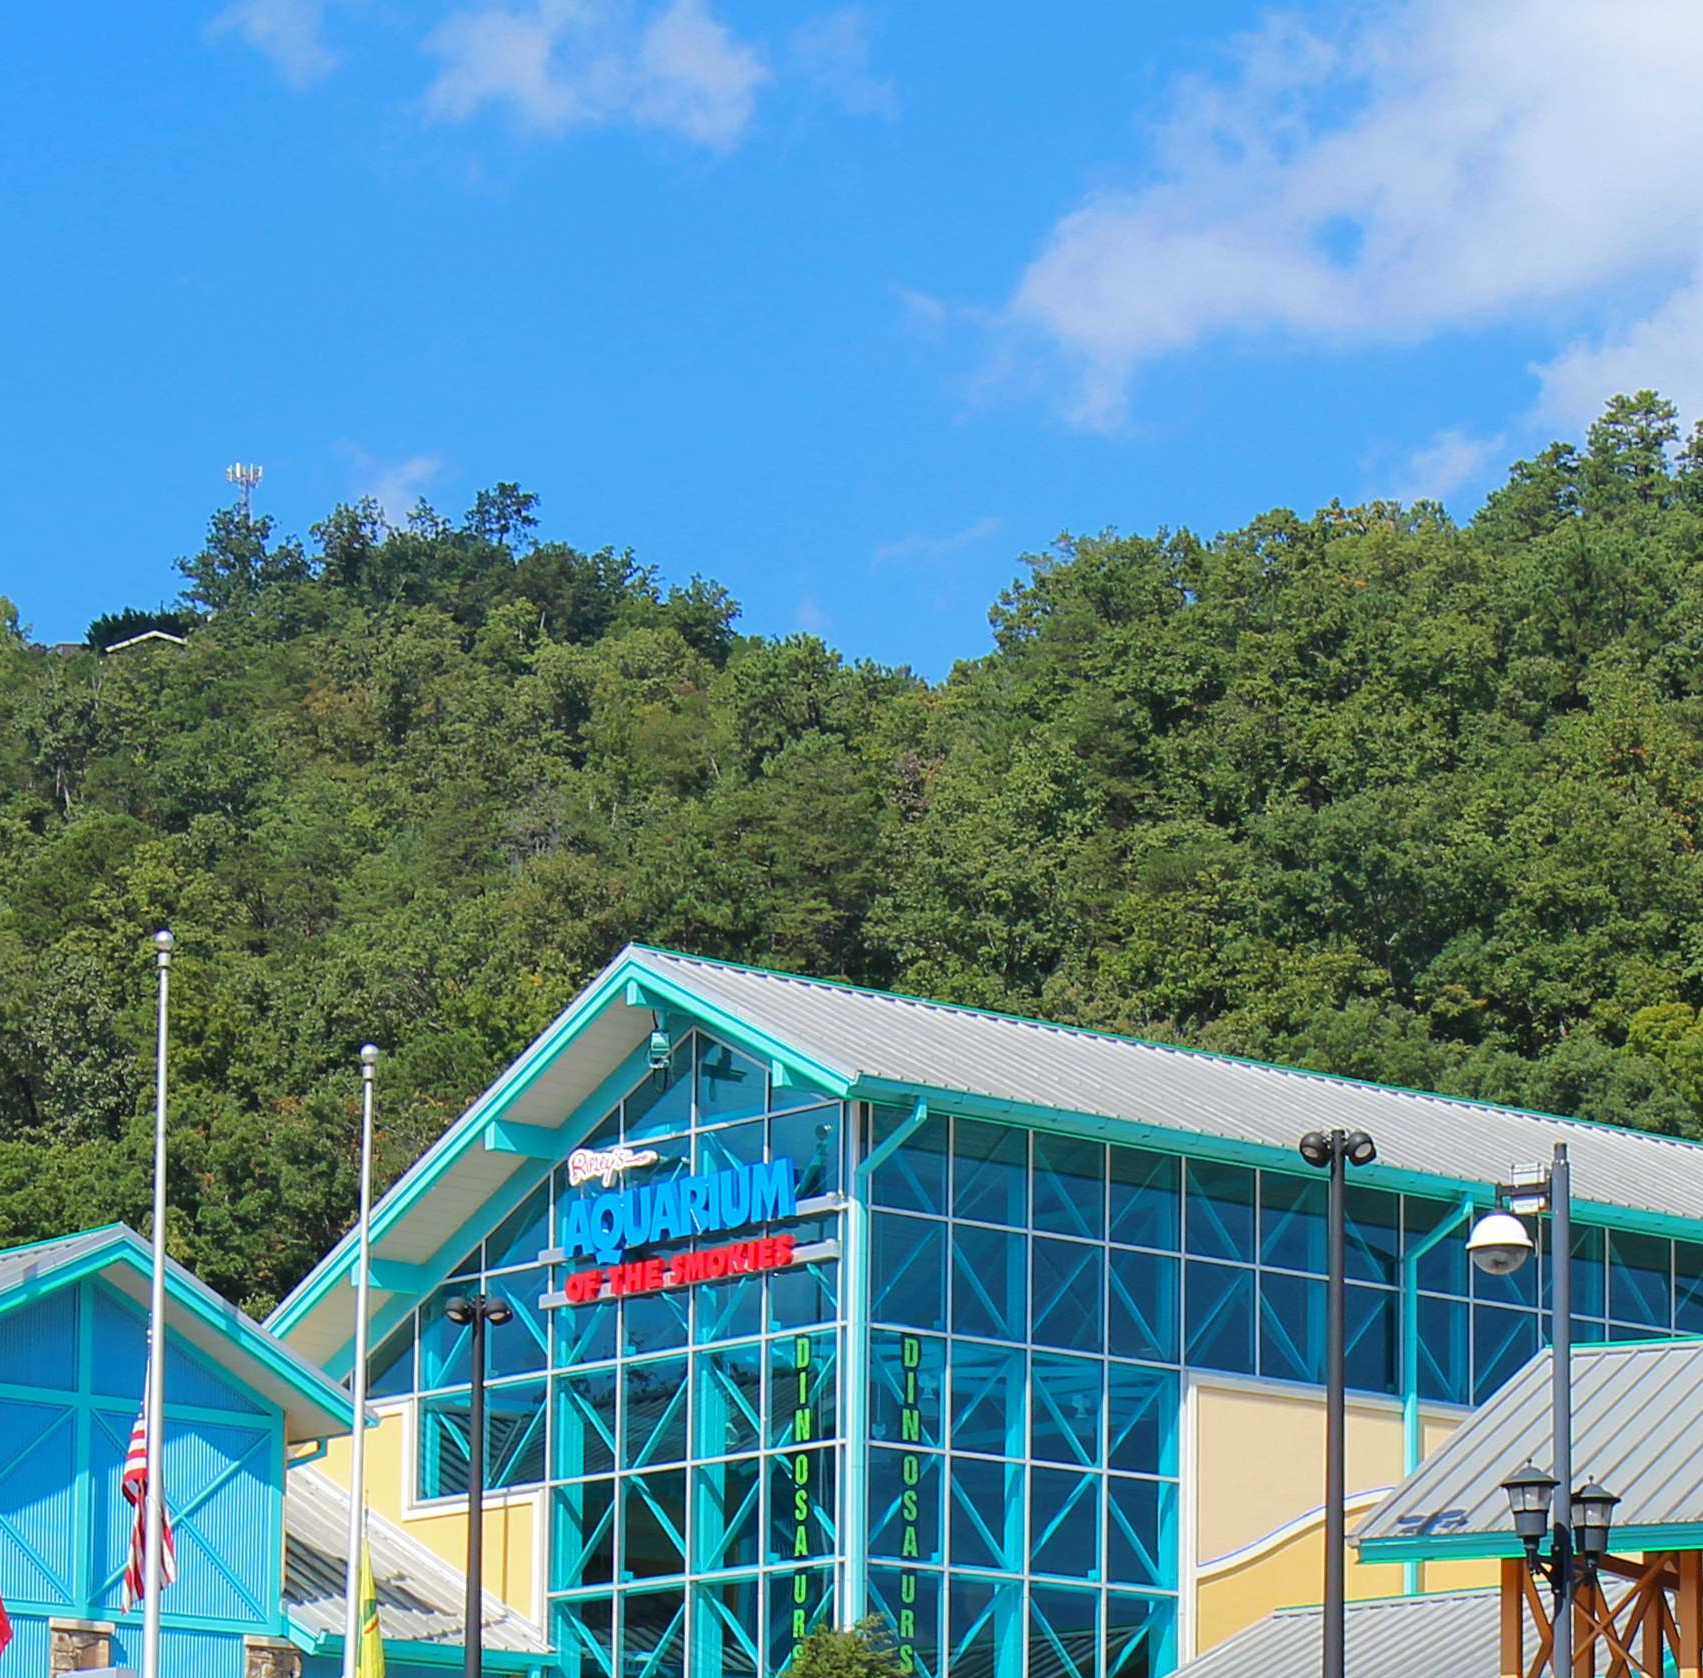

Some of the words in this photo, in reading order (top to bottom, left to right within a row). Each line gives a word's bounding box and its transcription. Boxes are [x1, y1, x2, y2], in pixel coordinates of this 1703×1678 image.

[563, 1158, 796, 1264] AQUARIUM
[565, 1271, 603, 1302] OF
[608, 1257, 666, 1296] THE
[670, 1234, 795, 1284] SMOKIES
[900, 1337, 919, 1674] DINOSAURS
